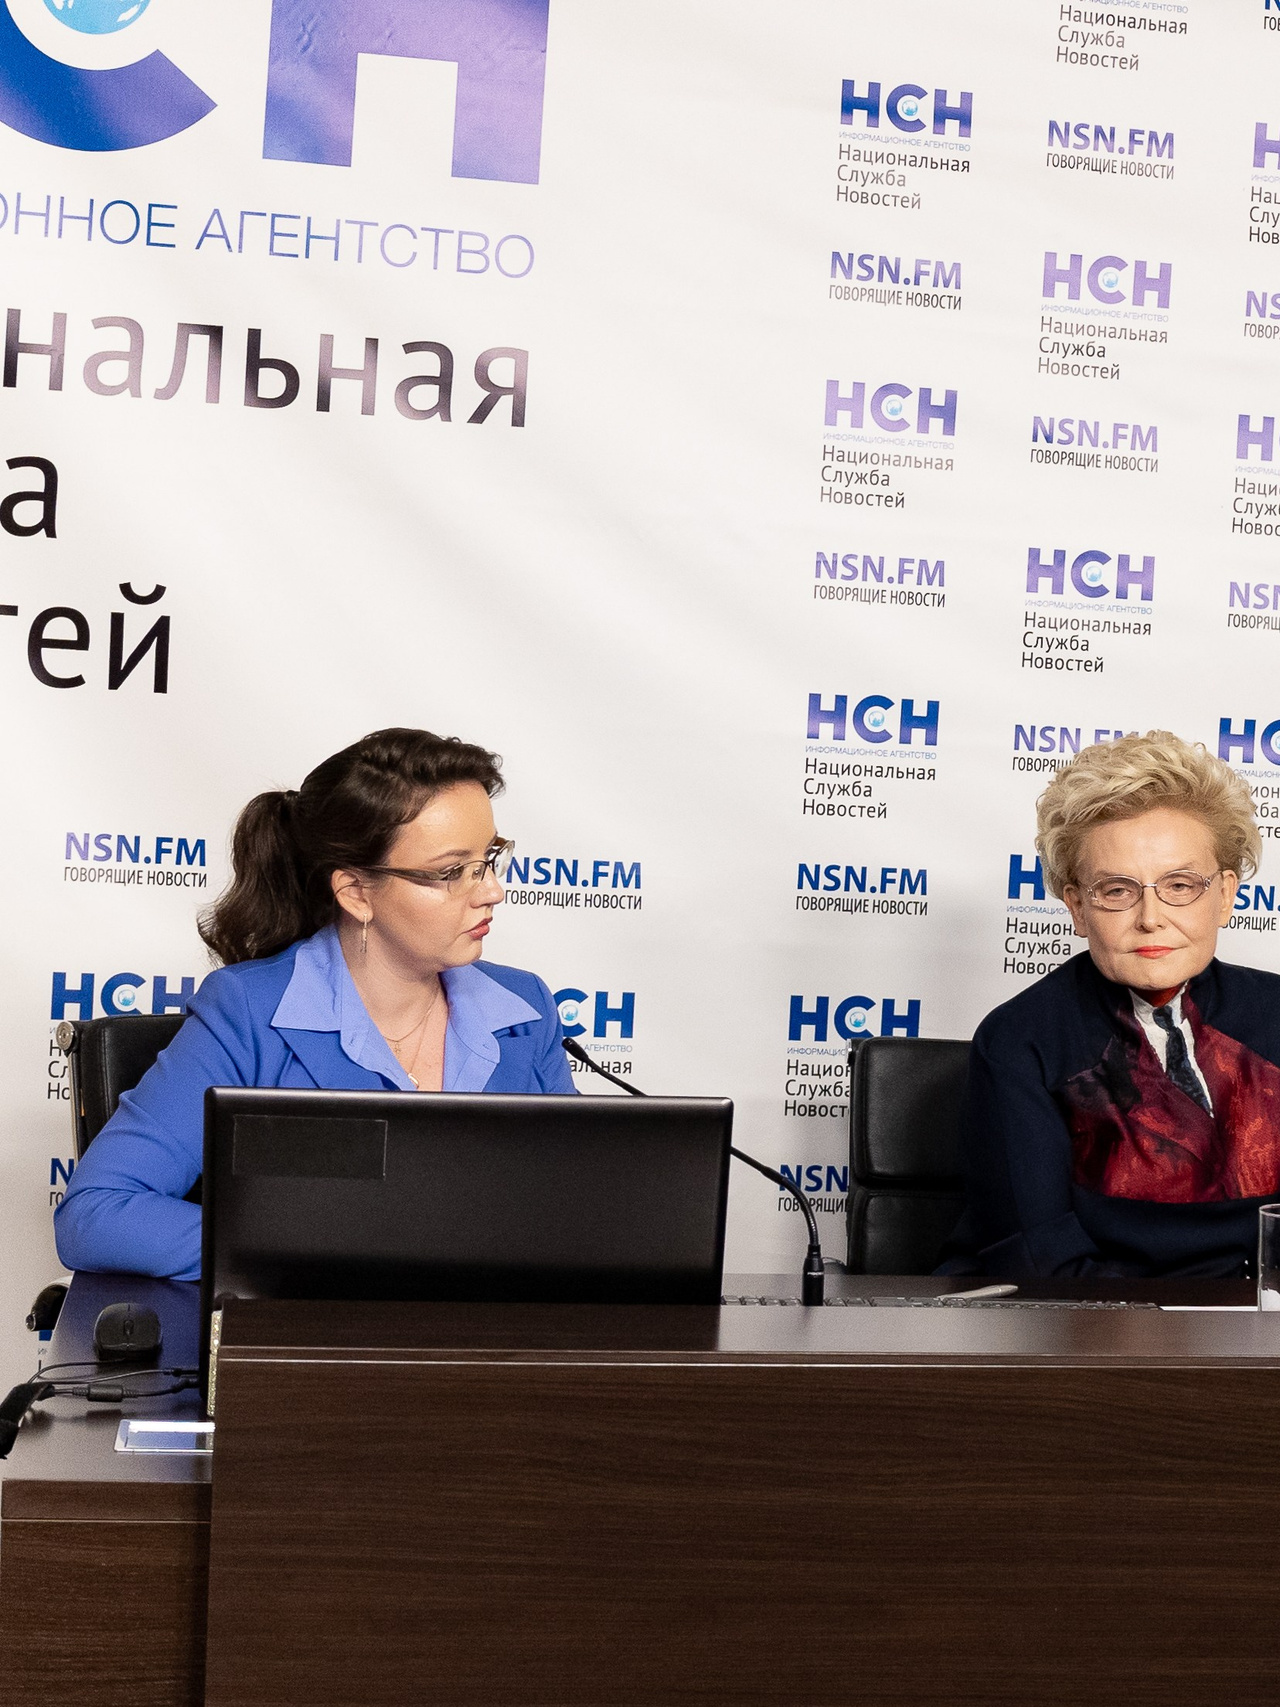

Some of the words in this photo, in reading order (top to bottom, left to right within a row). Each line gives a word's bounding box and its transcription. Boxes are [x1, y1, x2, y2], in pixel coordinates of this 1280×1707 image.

[841, 79, 973, 138] НСН
[1048, 120, 1174, 159] NSN.FM
[839, 144, 970, 172] Национальная
[1047, 153, 1117, 174] ГОВОРЯЩИЕ
[1121, 161, 1174, 179] НОВОСТИ
[838, 164, 905, 187] Служба
[837, 186, 920, 209] Новостей
[0, 192, 178, 248] ННОЕ
[195, 208, 534, 278] АГЕНТСТВО
[831, 251, 961, 289] NSN.FM
[1043, 252, 1172, 308] НСН
[830, 285, 902, 306] ГОВОРЯЩИЕ
[906, 292, 961, 310] НОВОСТИ
[1041, 316, 1167, 343] Национальная
[1039, 337, 1105, 359] Служба
[3, 308, 529, 428] нальная
[1038, 357, 1119, 380] Новостей
[1032, 416, 1157, 452] NSN.FM
[1031, 449, 1101, 469] ГОВОРЯЩИЕ
[1105, 455, 1158, 472] НОВОСТИ
[1026, 548, 1155, 601] НСН
[1025, 611, 1151, 635] Национальная
[0, 582, 170, 694] ей
[1023, 631, 1089, 653] Служба
[1022, 652, 1103, 672] Новостей
[807, 693, 940, 746] НСН
[805, 757, 935, 780] Национальная
[804, 778, 872, 799] Служба
[803, 798, 887, 818] Новостей
[66, 833, 206, 867] NSN.FM
[64, 867, 143, 886] ГОВОРЯЩИЕ
[147, 871, 207, 887] НОВОСТИ
[506, 857, 641, 889] NSN.FM
[797, 863, 927, 896] NSN.FM
[505, 890, 581, 909] ГОВОРЯЩИЕ
[584, 894, 642, 910] НОВОСТИ
[796, 896, 869, 915] ГОВОРЯЩИЕ
[872, 899, 928, 916] НОВОСТИ
[552, 988, 636, 1038] СН
